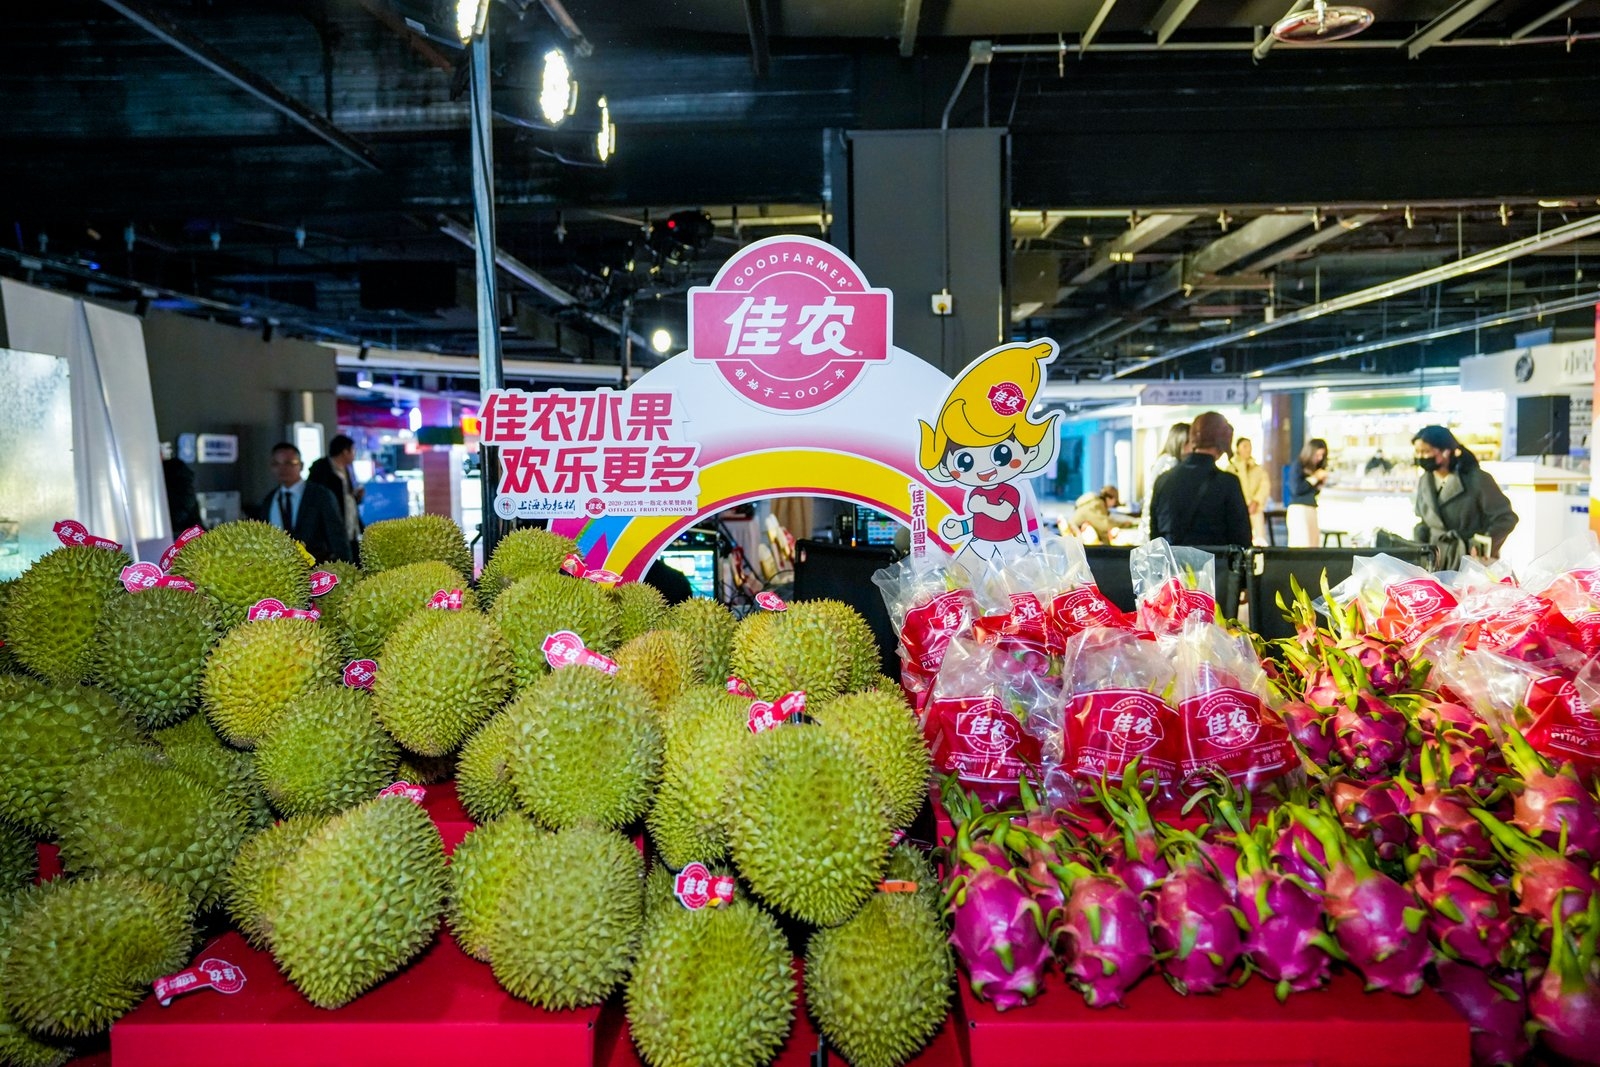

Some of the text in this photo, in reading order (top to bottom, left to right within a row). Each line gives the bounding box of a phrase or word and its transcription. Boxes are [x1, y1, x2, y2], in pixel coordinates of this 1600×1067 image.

[724, 296, 857, 356] 佳农
[993, 390, 1021, 411] 佳农
[481, 393, 672, 442] 佳农水果
[501, 446, 696, 494] 欢乐更多
[59, 526, 87, 545] 佳农
[127, 570, 158, 587] 佳农
[1070, 599, 1109, 622] 佳农
[549, 641, 580, 662] 佳农
[1111, 712, 1156, 736] 佳农
[1206, 707, 1253, 737] 佳农
[683, 877, 709, 896] 佳农
